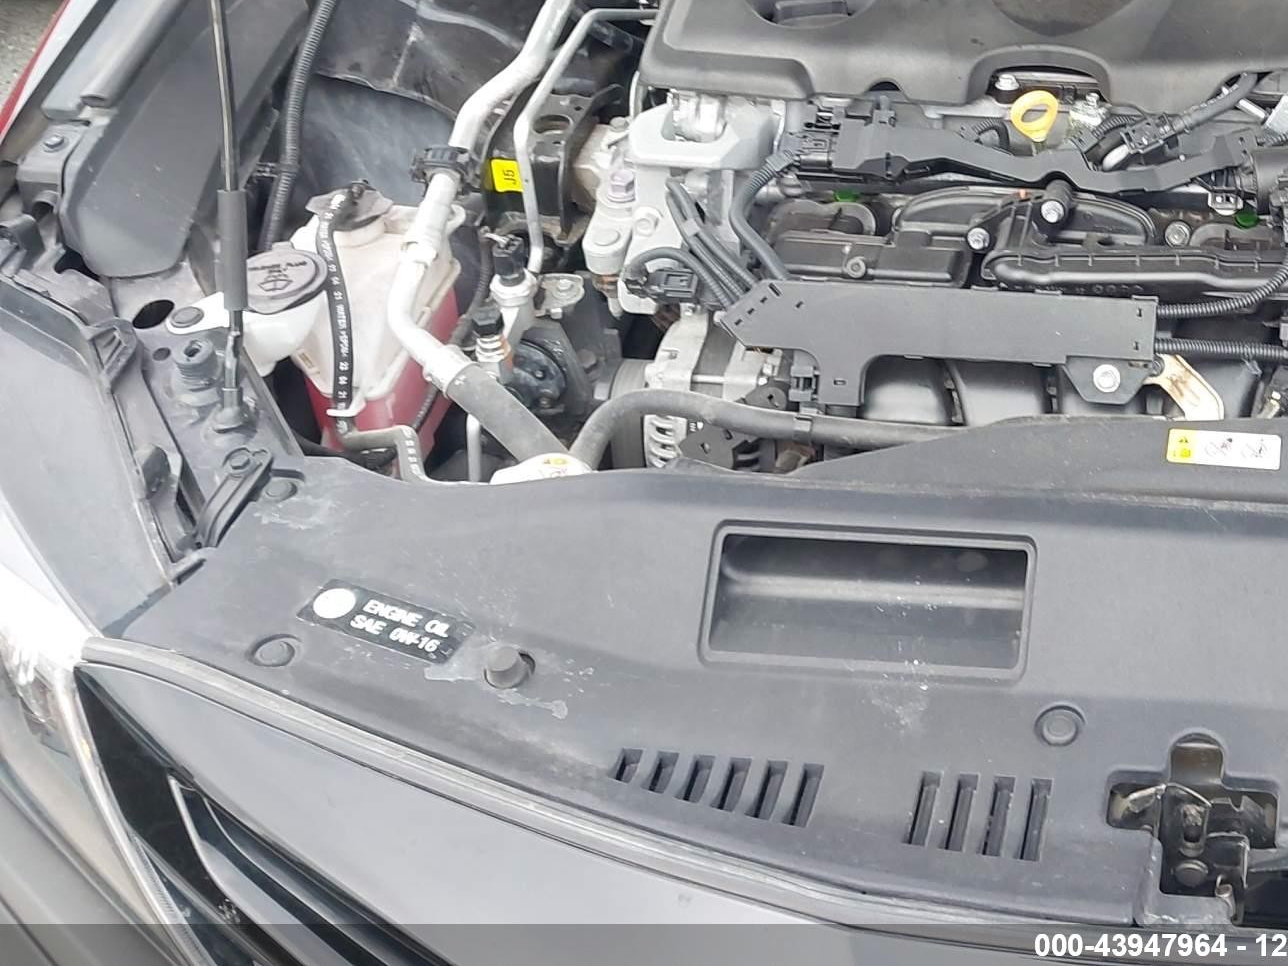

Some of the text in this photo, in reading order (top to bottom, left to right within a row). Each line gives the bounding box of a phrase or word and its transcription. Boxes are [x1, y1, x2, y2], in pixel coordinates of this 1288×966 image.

[350, 614, 387, 635] SAE
[362, 599, 450, 638] ENGINE OIL
